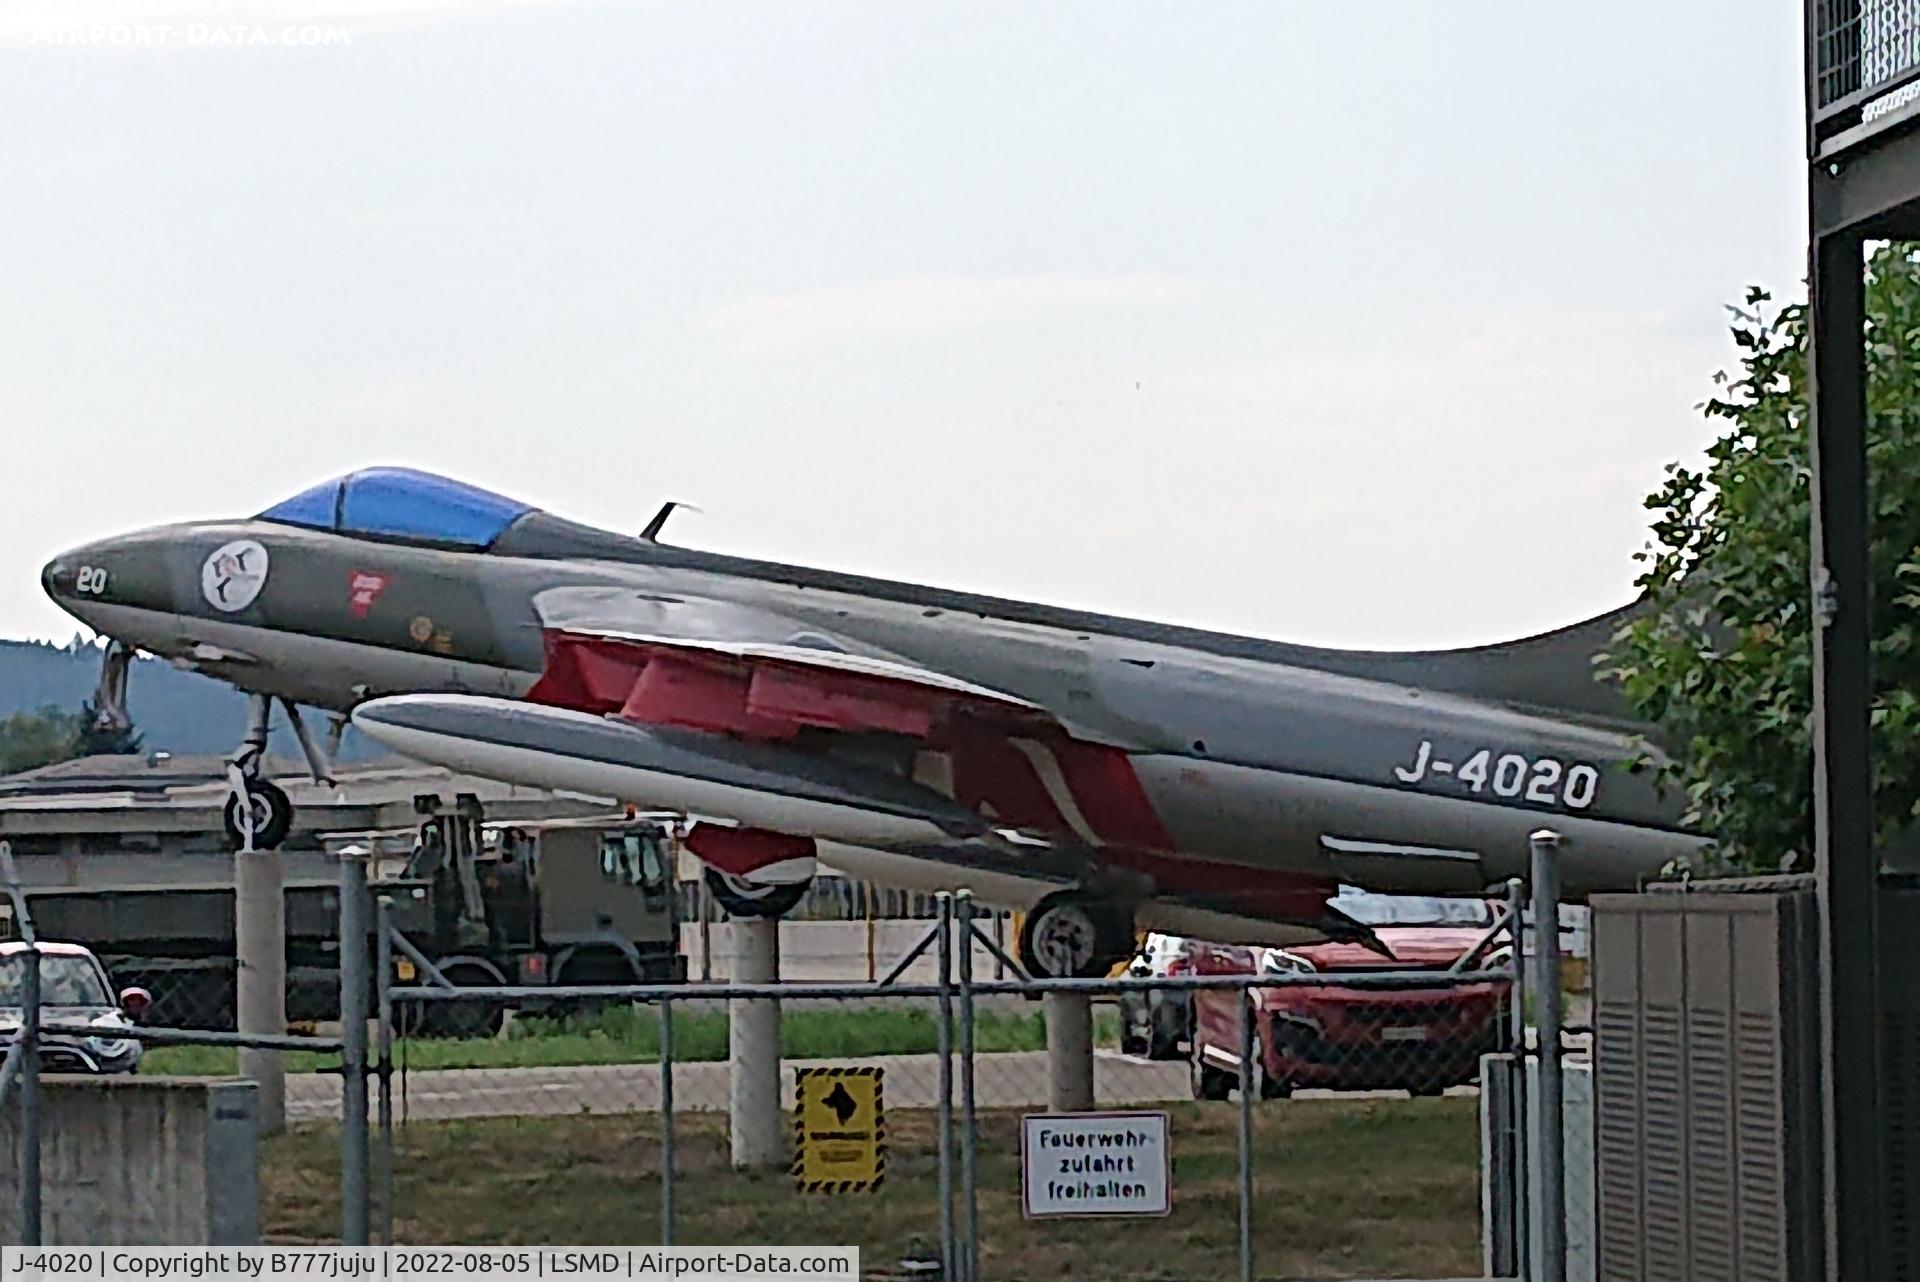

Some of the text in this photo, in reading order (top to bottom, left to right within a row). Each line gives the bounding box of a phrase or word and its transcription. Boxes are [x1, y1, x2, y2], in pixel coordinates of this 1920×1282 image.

[76, 565, 108, 595] 20
[1394, 740, 1599, 809] J-4020
[1059, 1154, 1135, 1174] zufahrt
[1048, 1180, 1146, 1200] freihalten
